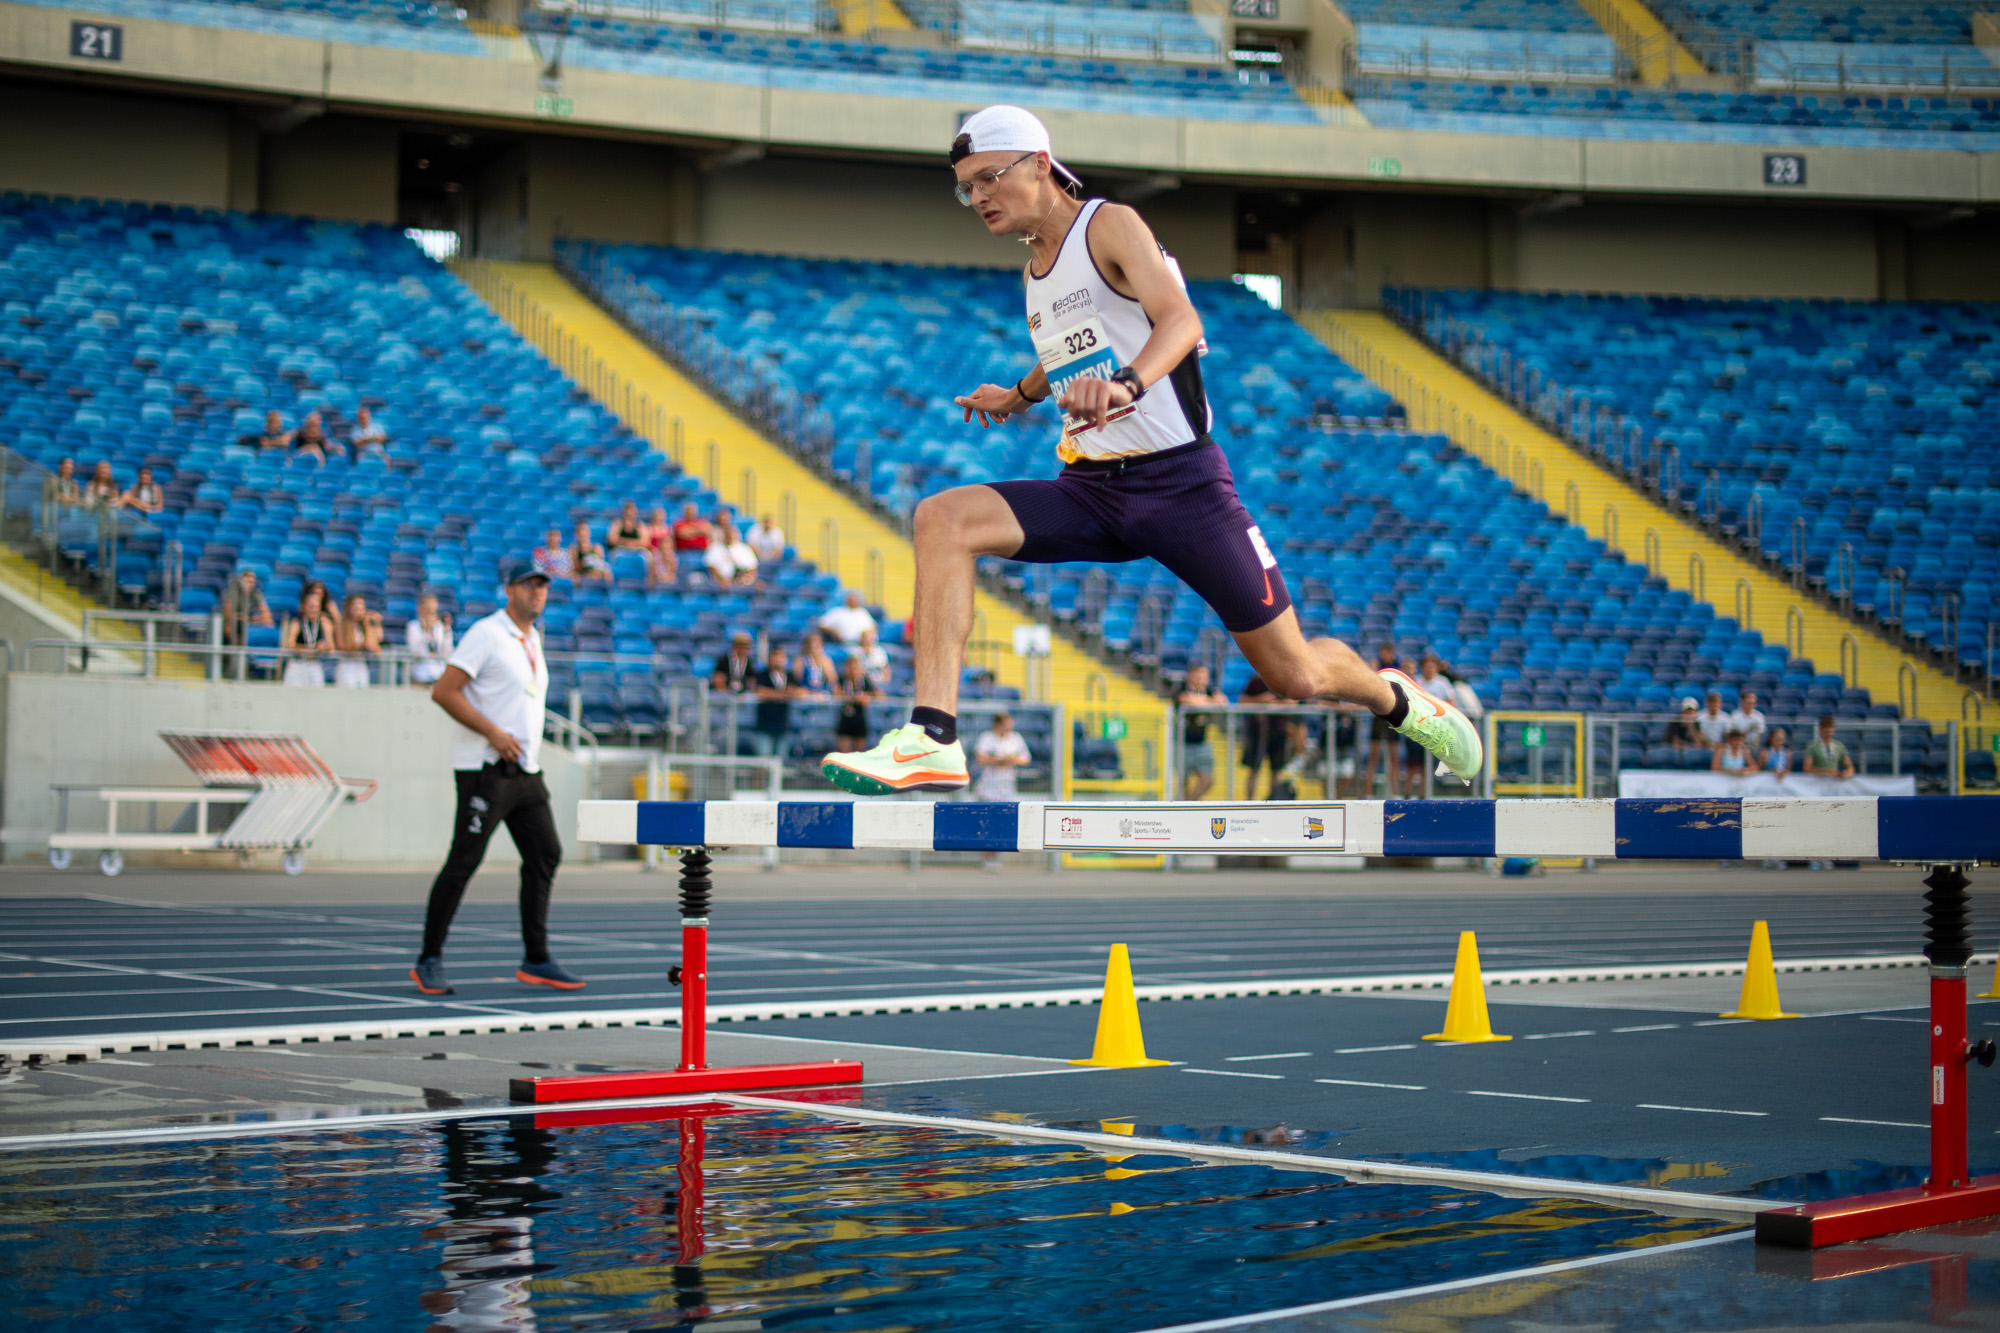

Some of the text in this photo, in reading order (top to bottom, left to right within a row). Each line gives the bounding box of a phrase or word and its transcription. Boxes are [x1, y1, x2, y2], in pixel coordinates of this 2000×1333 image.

[80, 26, 112, 57] 21
[1771, 157, 1798, 183] 23
[1065, 328, 1097, 355] 323
[1050, 358, 1115, 404] BRAYK
